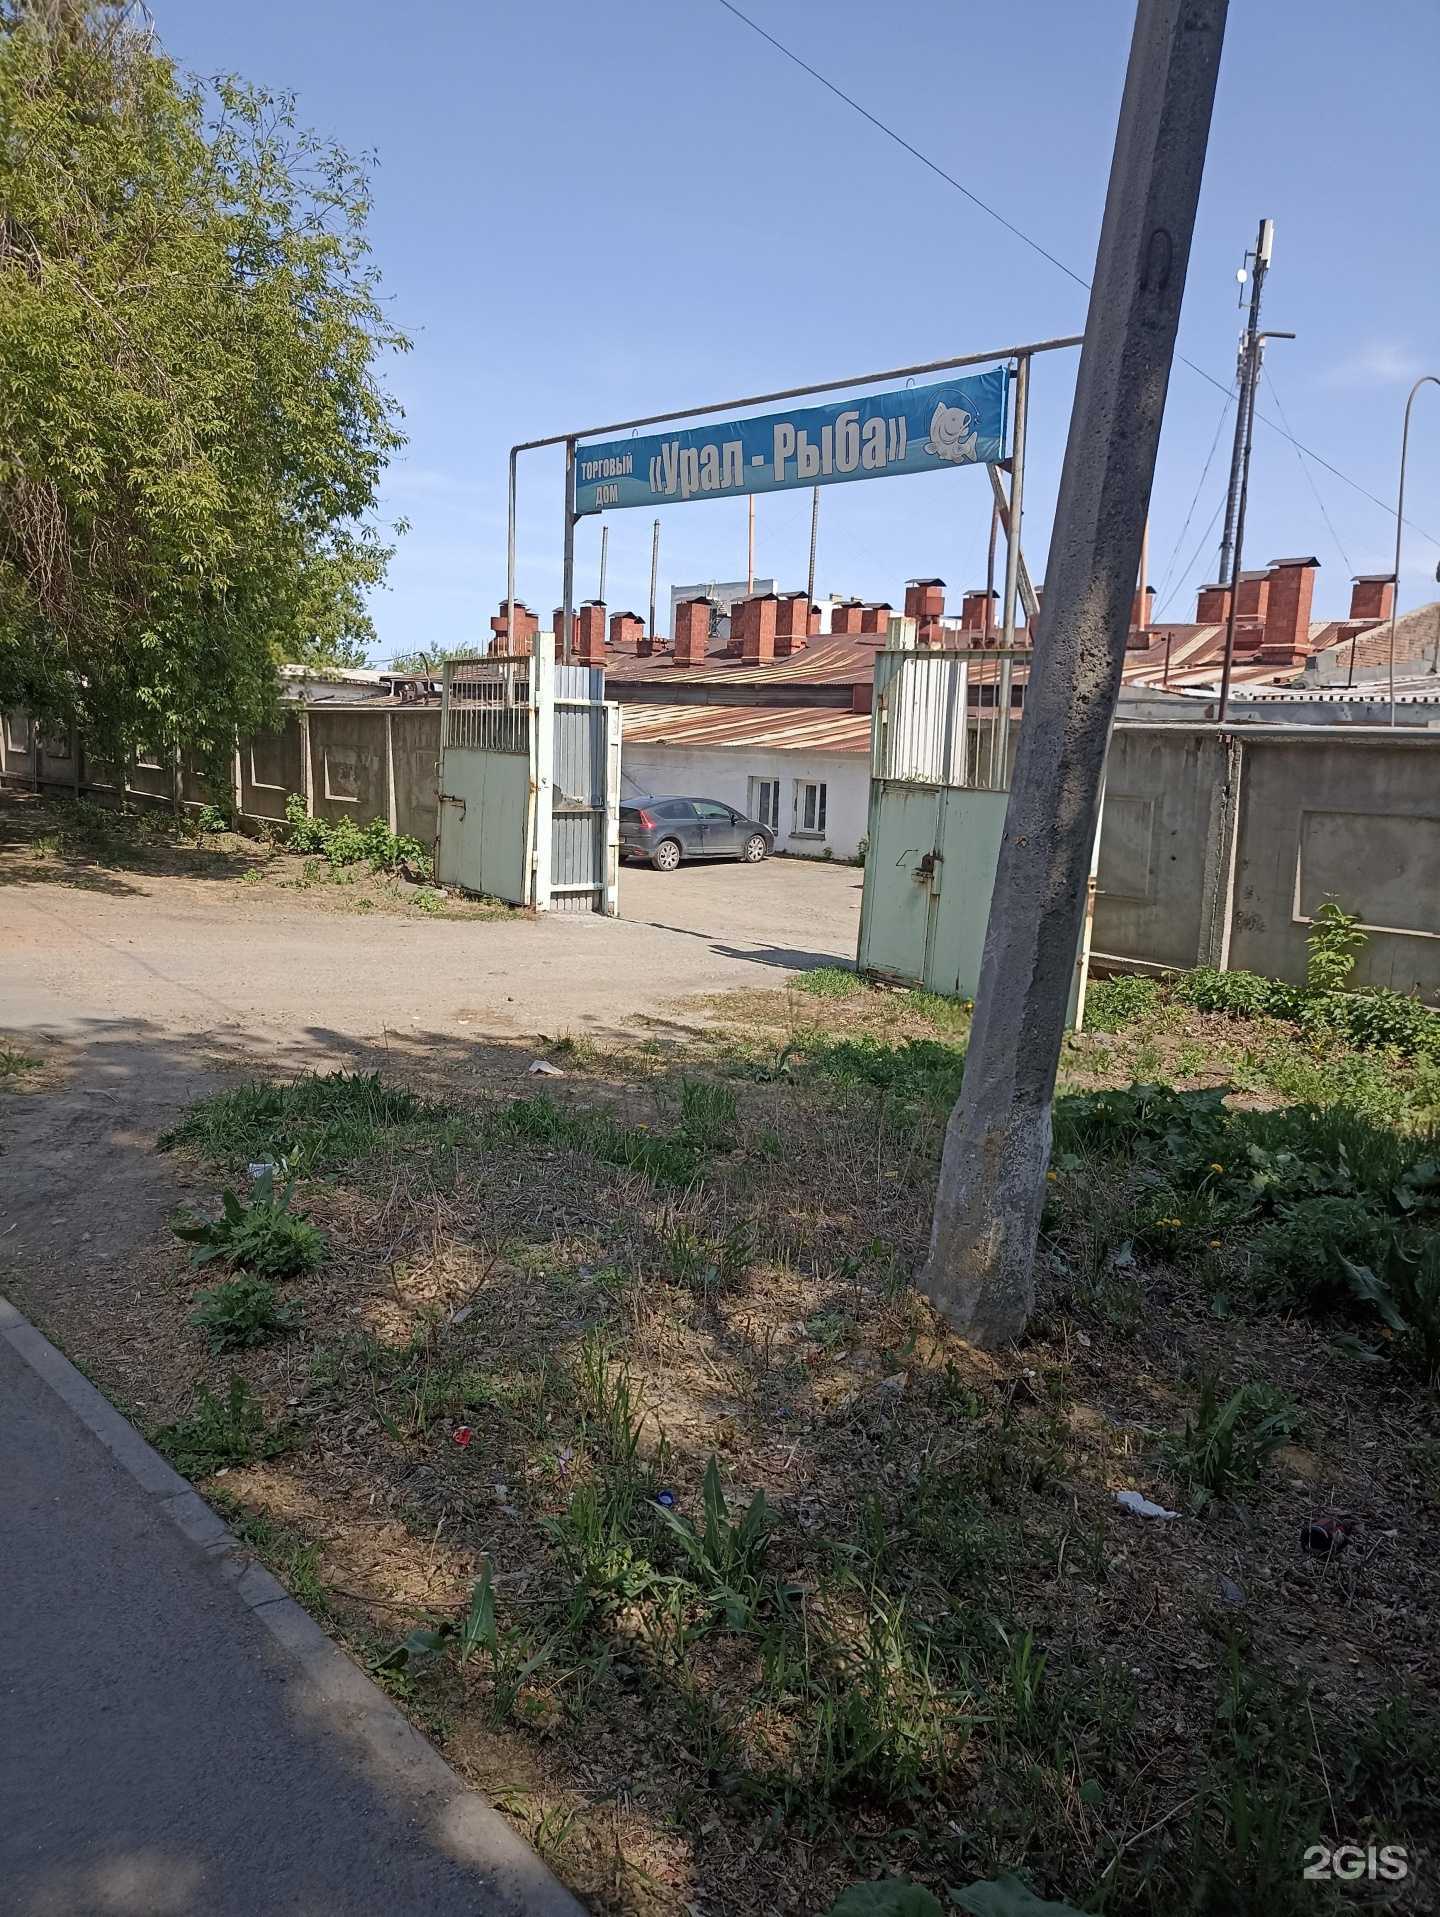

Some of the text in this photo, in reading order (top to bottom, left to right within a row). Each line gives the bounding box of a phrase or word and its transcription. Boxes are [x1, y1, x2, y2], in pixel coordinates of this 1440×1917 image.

[581, 451, 633, 480] ТОРГОВЫЙ
[650, 440, 744, 498] «Урал
[773, 411, 907, 481] Рыба»
[595, 484, 618, 507] ДОМ
